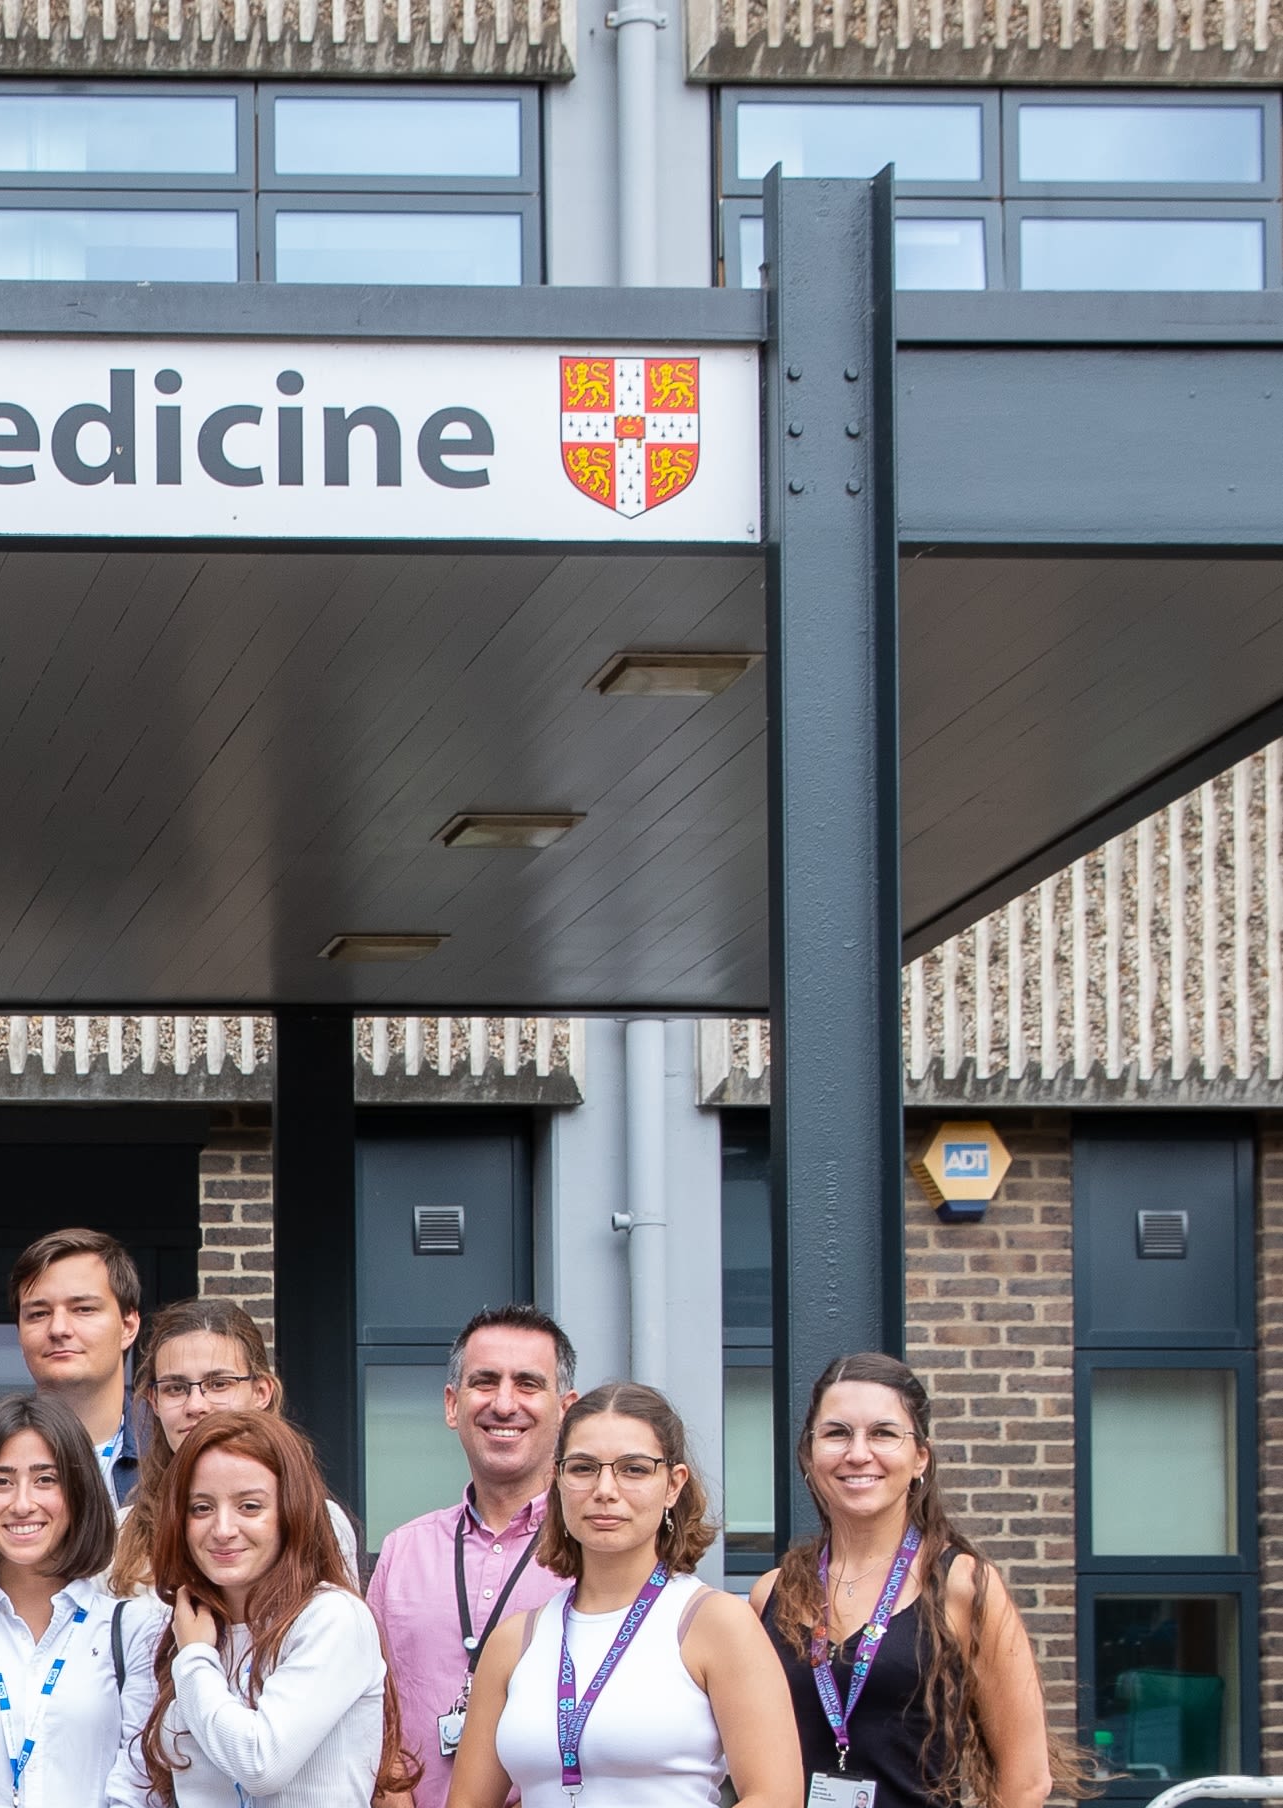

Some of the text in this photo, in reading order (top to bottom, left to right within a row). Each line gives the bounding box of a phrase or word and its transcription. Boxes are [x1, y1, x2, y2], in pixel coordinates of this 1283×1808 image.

[945, 1150, 988, 1171] ADT
[881, 1555, 907, 1602] CLINICAL
[589, 1593, 651, 1691] CLINICAL SCHOOL
[46, 1668, 59, 1685] NHS
[818, 1663, 841, 1712] CAMBRIDGE
[15, 1752, 28, 1769] NHS
